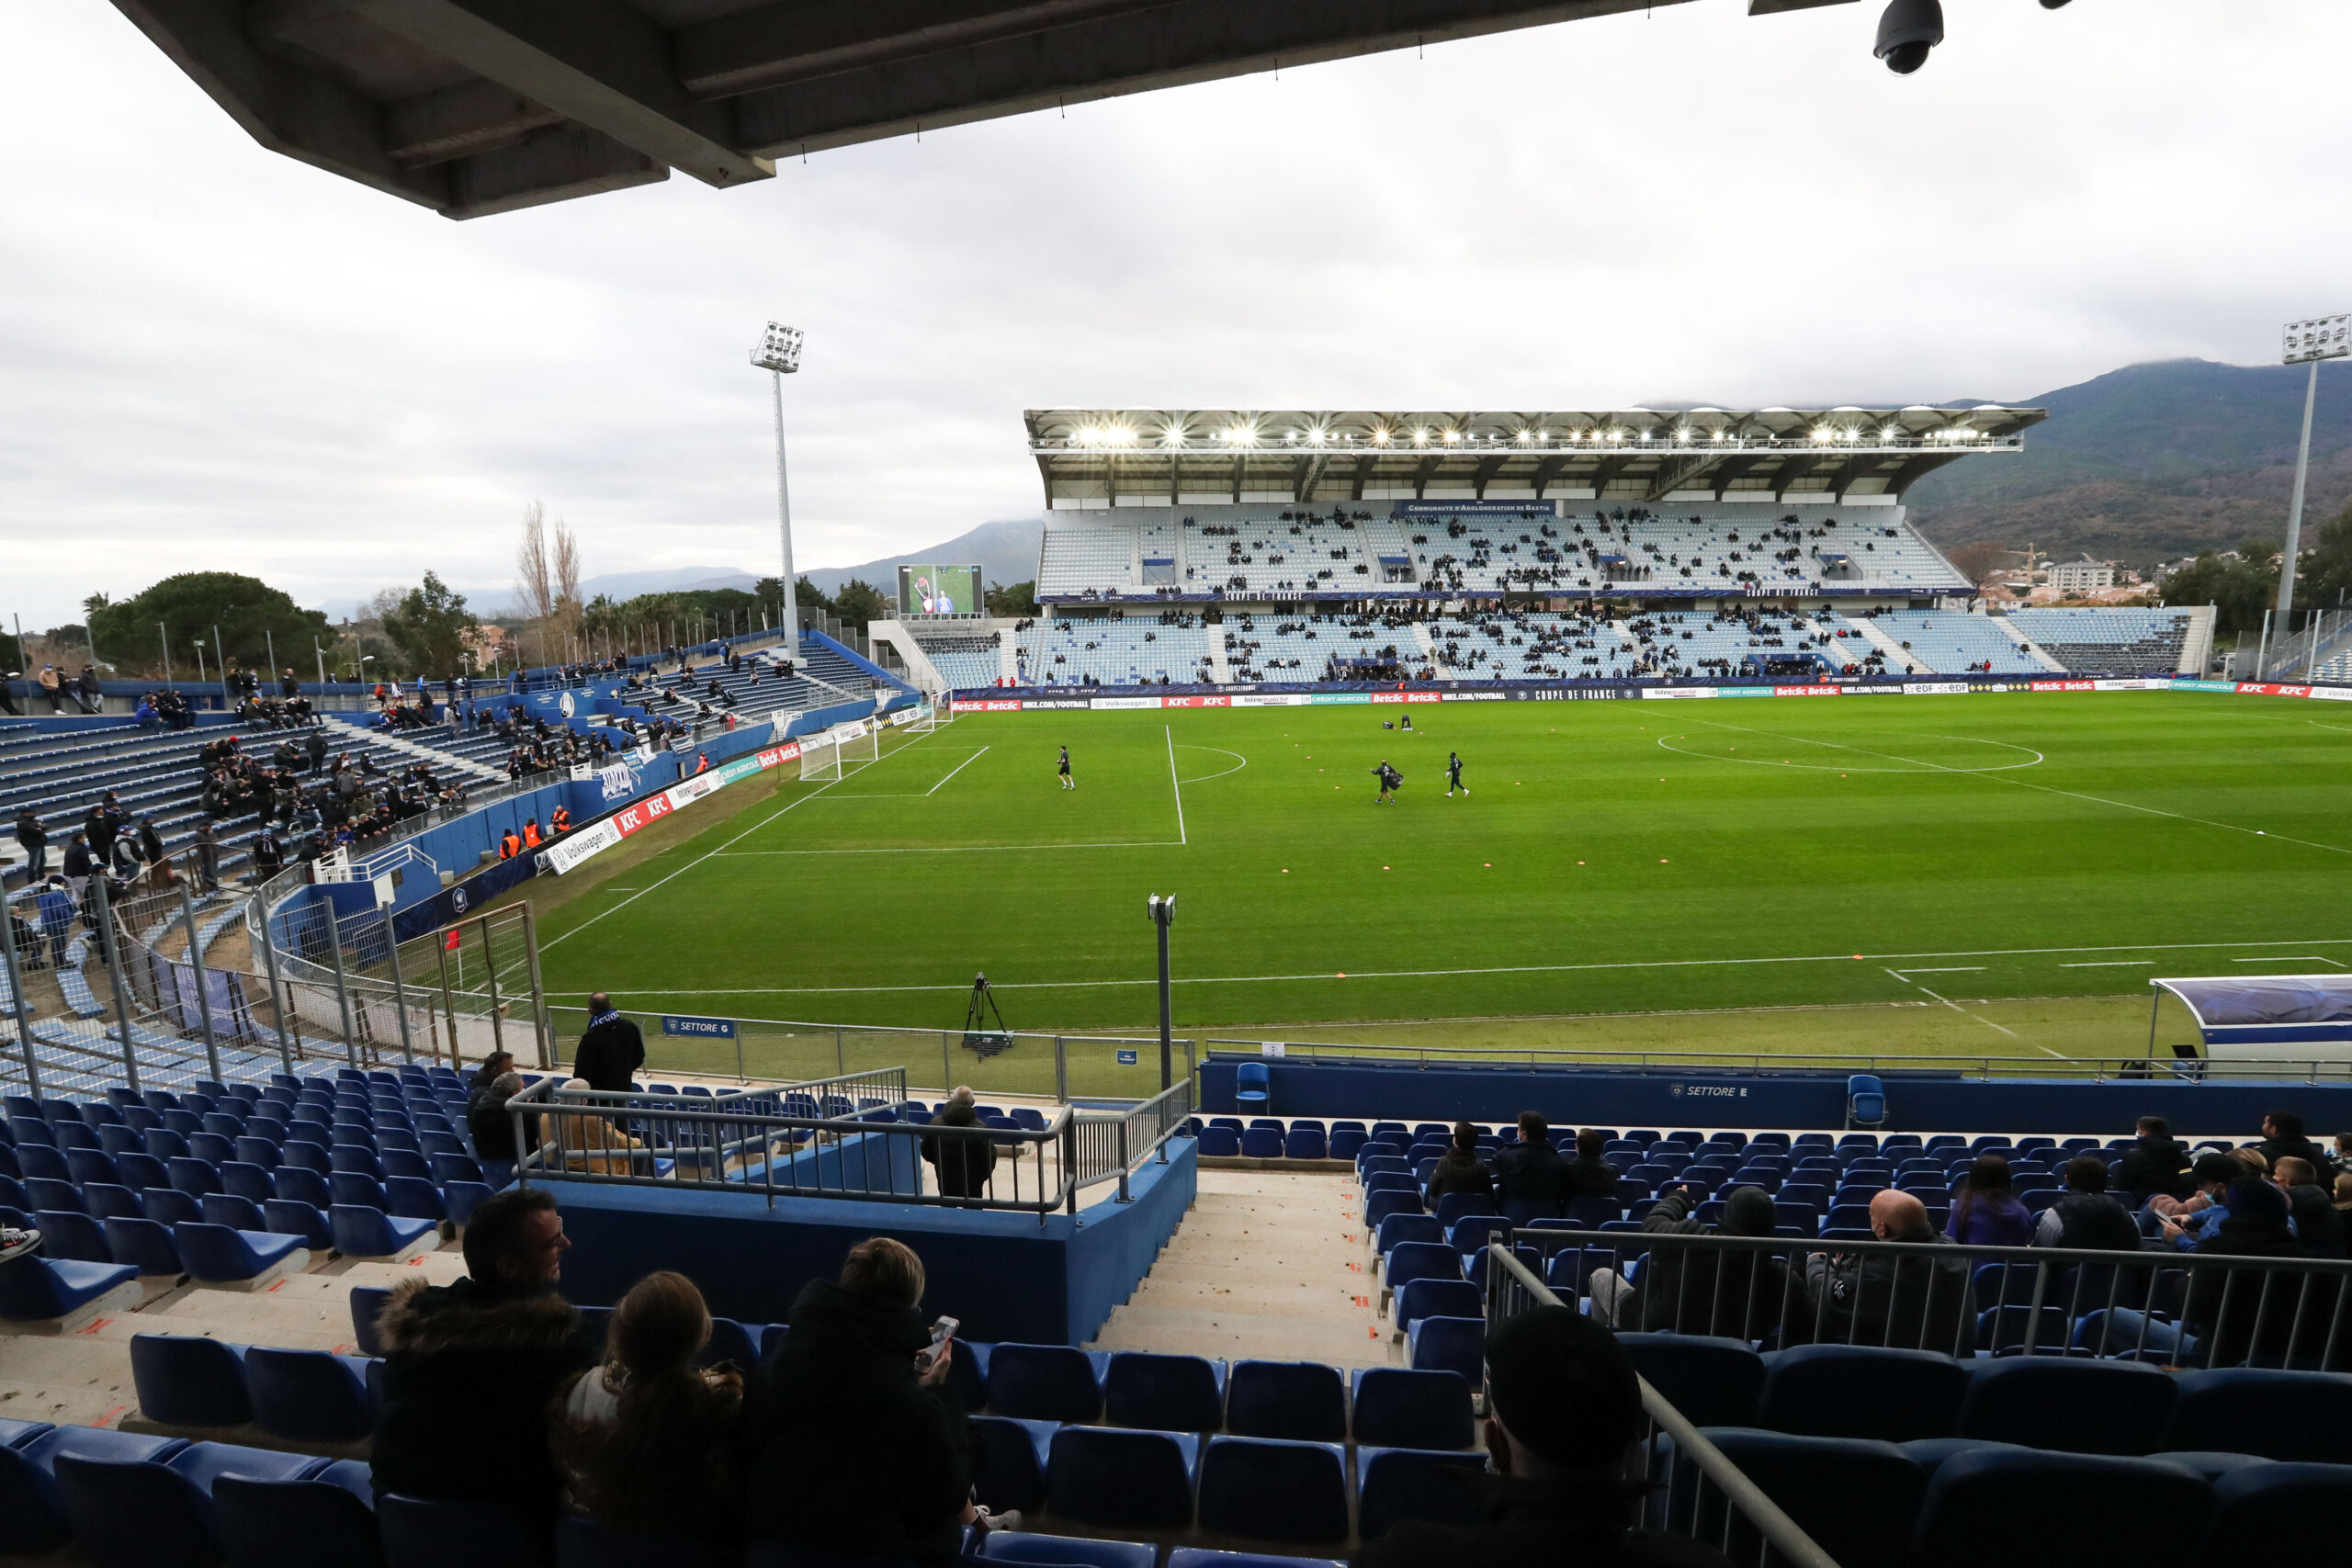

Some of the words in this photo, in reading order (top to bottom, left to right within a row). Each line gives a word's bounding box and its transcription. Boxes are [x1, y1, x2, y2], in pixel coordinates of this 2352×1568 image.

[1225, 592, 1250, 601] COUPE
[1256, 592, 1265, 601] DE
[1747, 589, 1770, 597] COUPE
[1776, 687, 1805, 695] Betclic
[1808, 687, 1838, 695] Betclic
[1841, 685, 1902, 694] NIKE.COM/FOOTBALL
[2033, 682, 2062, 691] Betclic
[2064, 682, 2093, 690] Betclic
[2240, 683, 2267, 693] KFC
[2278, 685, 2305, 695] KFC
[1373, 694, 1404, 703] Betclic
[1408, 694, 1438, 702] Betclic
[1535, 691, 1563, 700] COUPE
[1567, 690, 1578, 699] DE
[1582, 690, 1616, 699] FRANCE
[1022, 701, 1089, 709] NIKE.COM/FOOTBALL
[1168, 698, 1191, 706] KFC
[1204, 697, 1226, 705] KFC
[952, 702, 983, 711] Betclic
[987, 702, 1018, 710] Betclic
[758, 751, 781, 767] Betclic
[779, 745, 800, 761] Betclic
[736, 760, 760, 774] AGRICOLE
[619, 809, 641, 831] KFC
[646, 796, 668, 818] KFC
[563, 830, 606, 860] Volkswagen
[681, 1021, 718, 1032] SETTORE
[720, 1024, 729, 1032] G
[1687, 1086, 1736, 1097] SETTORE
[1739, 1088, 1747, 1097] E
